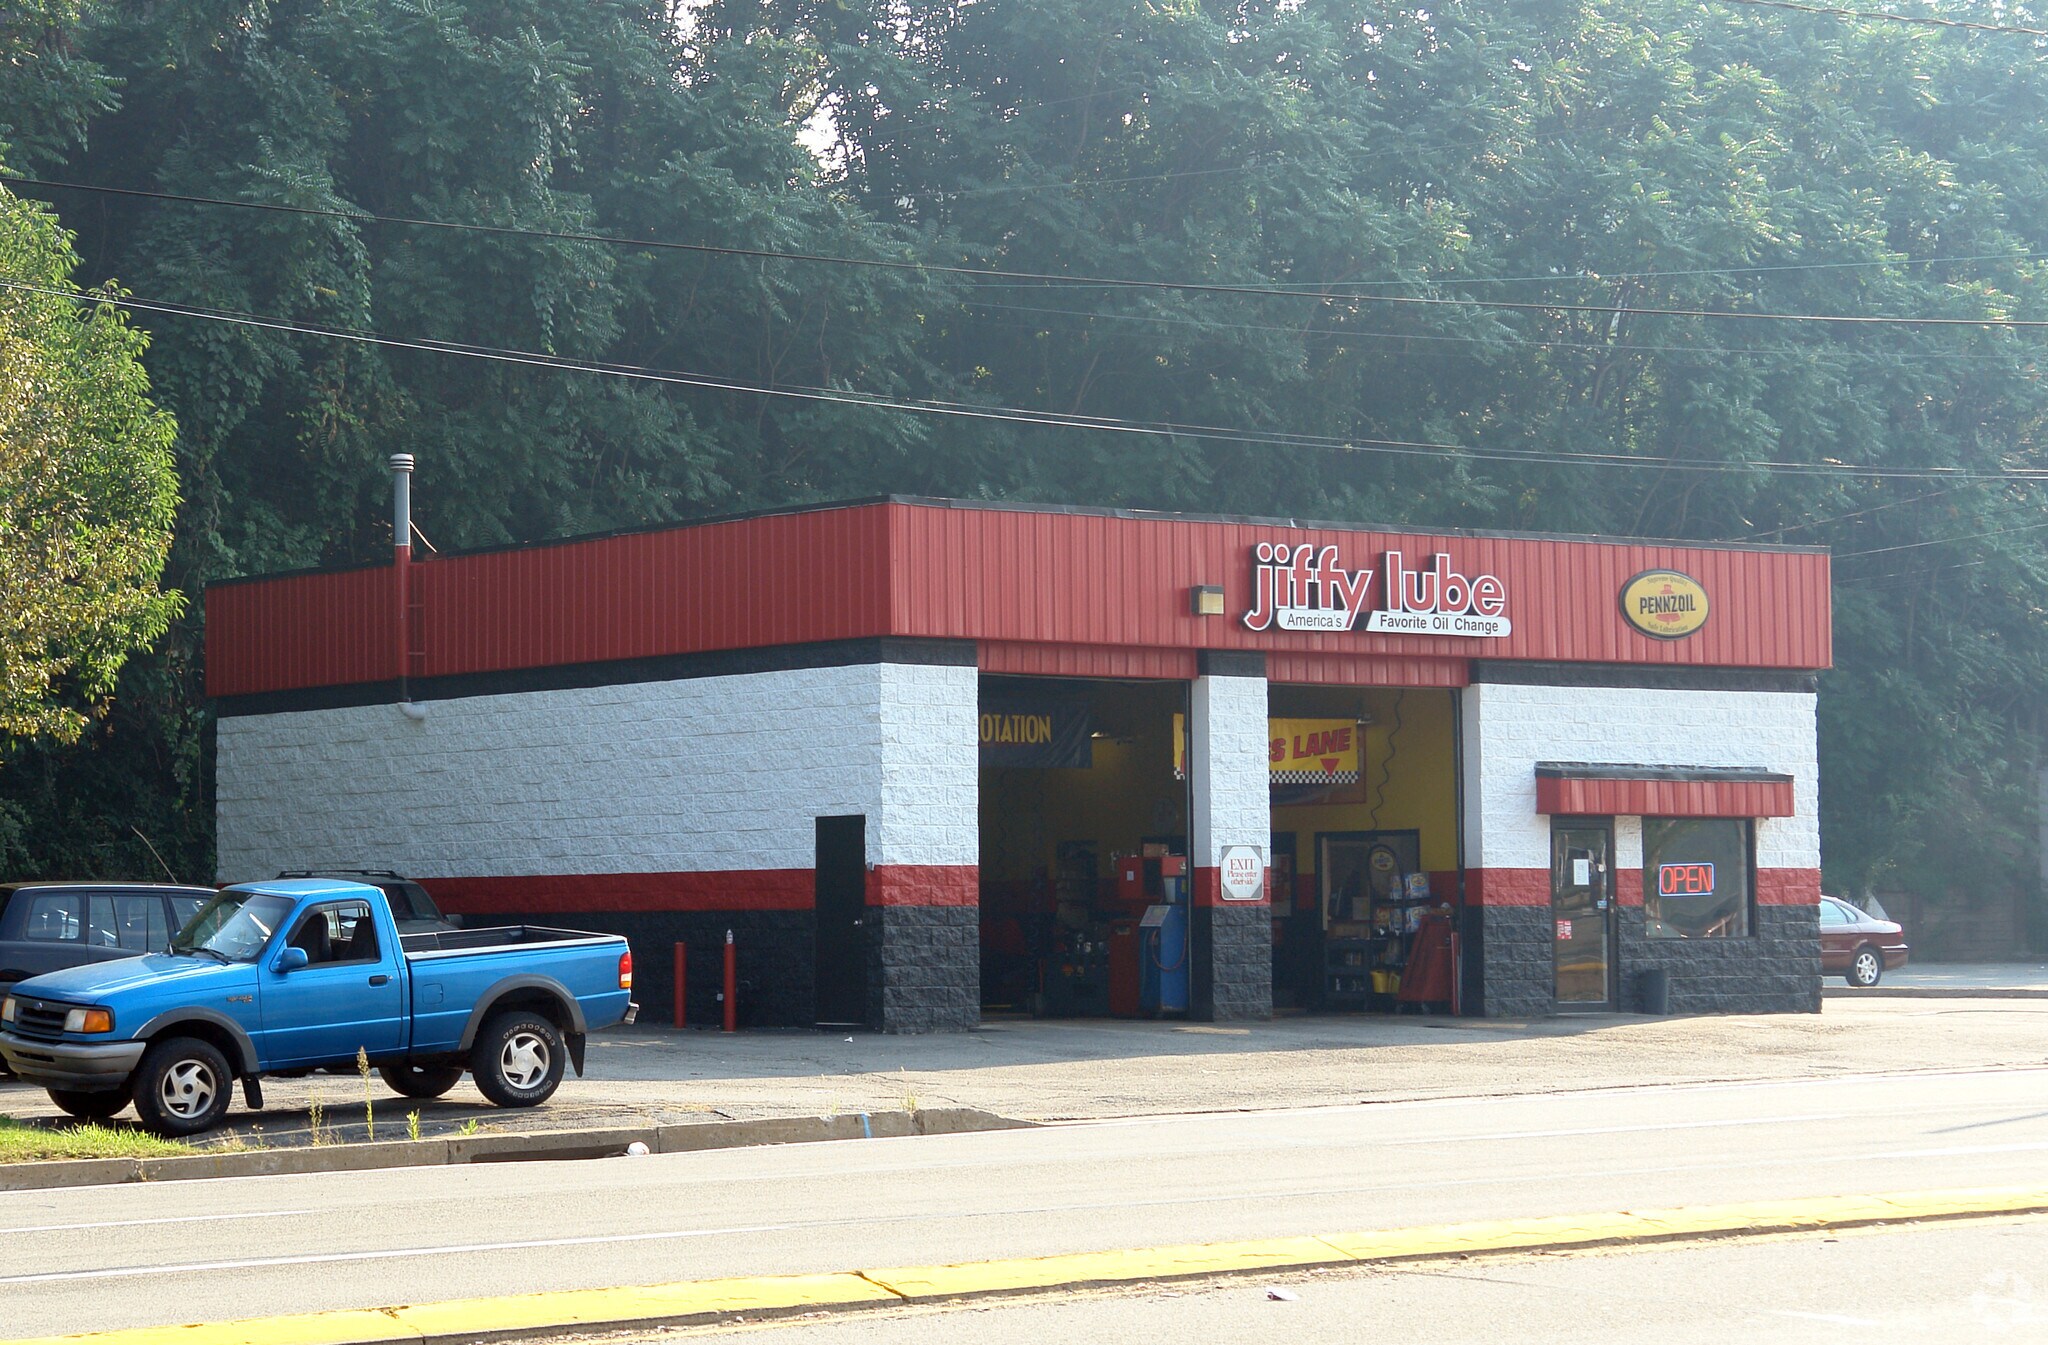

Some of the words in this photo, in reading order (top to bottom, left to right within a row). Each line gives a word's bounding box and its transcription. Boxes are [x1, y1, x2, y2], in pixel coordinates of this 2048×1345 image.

[1243, 542, 1373, 630] jiffy
[1386, 551, 1505, 617] lube
[1640, 593, 1696, 614] PENNZOIL
[1287, 613, 1342, 628] America's
[1380, 615, 1427, 629] Favorite
[1432, 617, 1449, 630] Oil
[1454, 618, 1499, 635] Change
[979, 713, 1052, 744] OTATION
[1293, 728, 1352, 760] LANE
[1230, 858, 1256, 870] EXIT
[1661, 865, 1712, 893] OPEN
